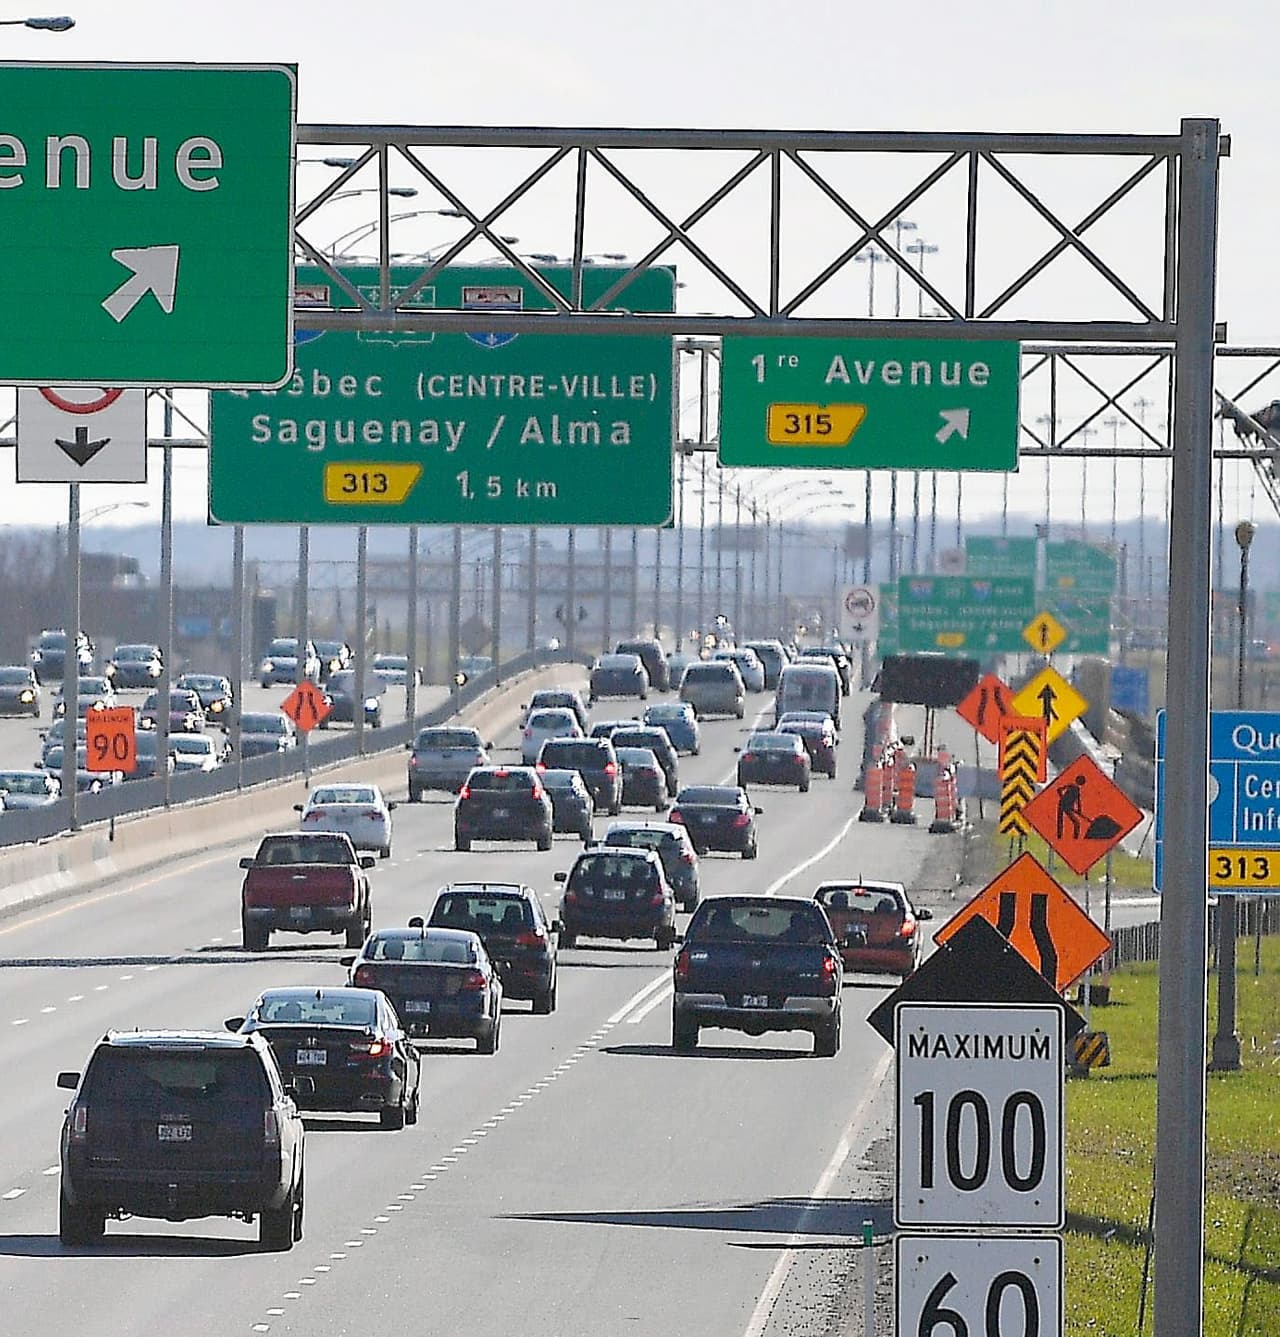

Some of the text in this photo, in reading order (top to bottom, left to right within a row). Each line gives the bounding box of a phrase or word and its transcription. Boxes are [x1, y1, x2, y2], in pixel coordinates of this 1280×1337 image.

[751, 352, 992, 387] 1 re Avenue
[230, 366, 659, 402] ébec (CENTRE-VILLE)
[251, 413, 466, 452] Saguenay
[519, 415, 632, 446] Alma
[783, 413, 833, 436] 315
[341, 473, 389, 494] 313
[517, 476, 558, 498] km
[94, 733, 130, 761] 90
[1231, 724, 1280, 755] Qu
[1244, 775, 1280, 799] Ce
[1243, 806, 1280, 832] Inf
[1214, 856, 1270, 880] 313
[908, 1033, 1052, 1060] MAXIMUM
[913, 1089, 1047, 1193] 100
